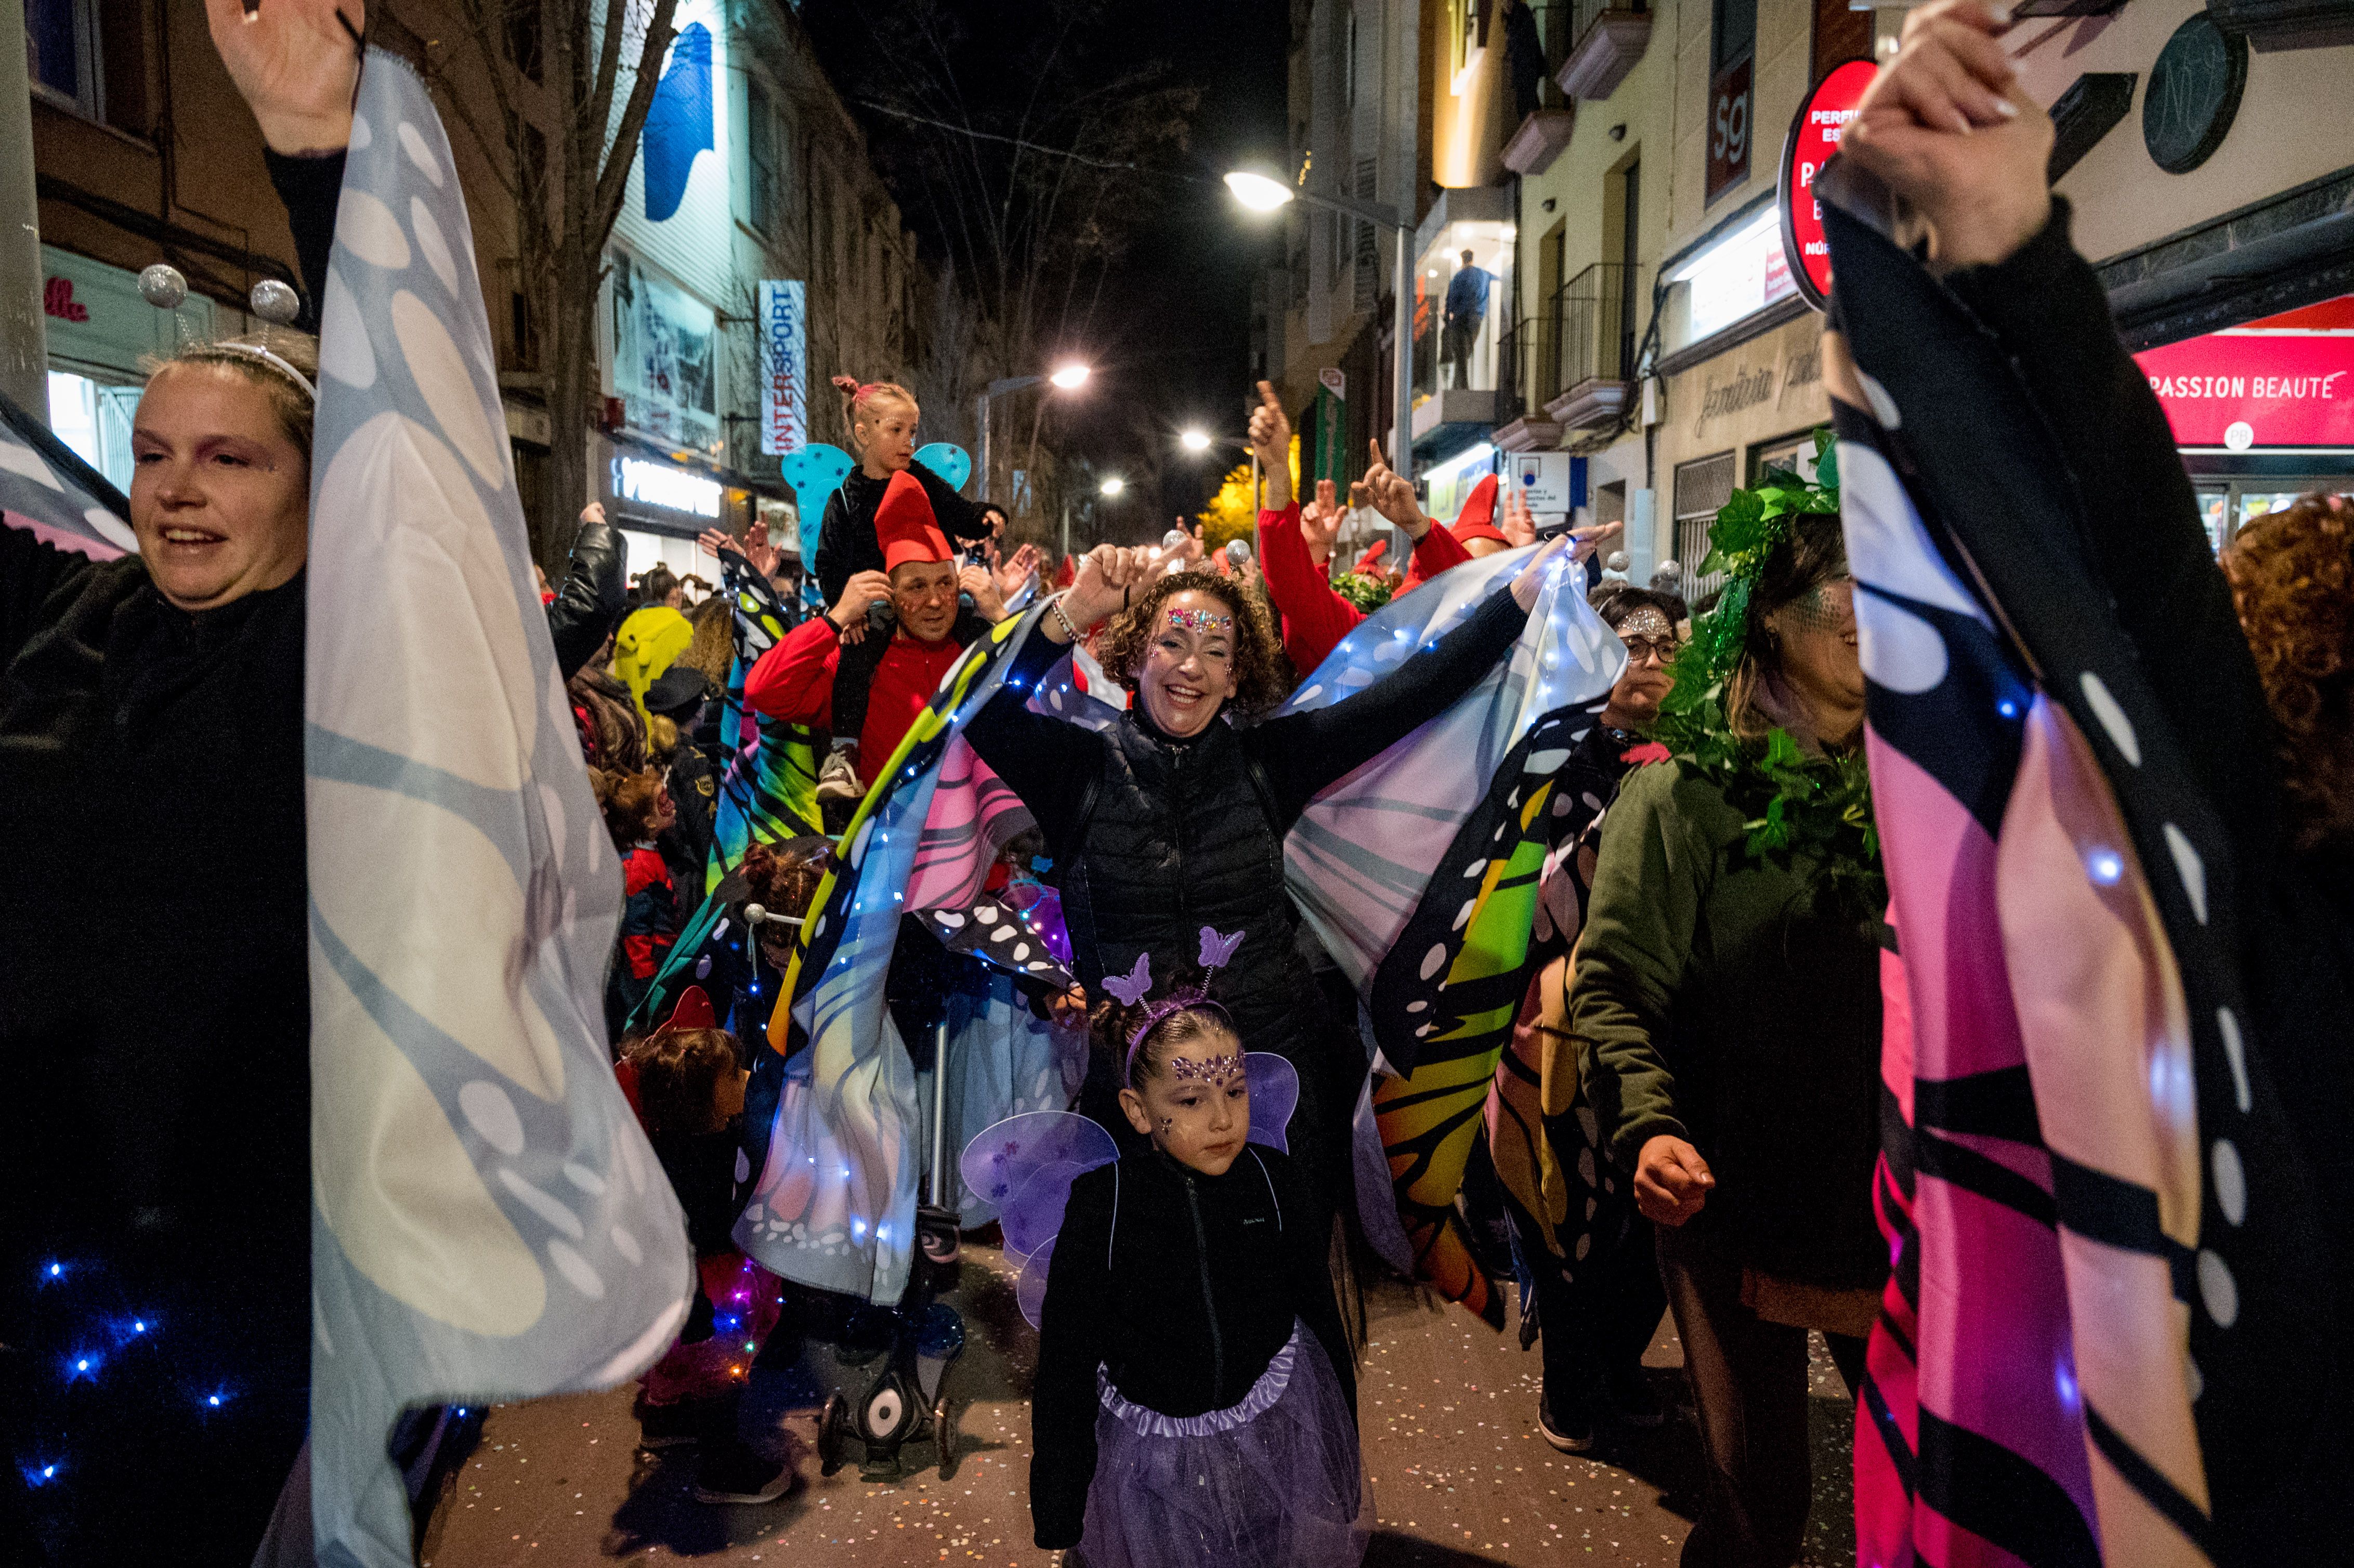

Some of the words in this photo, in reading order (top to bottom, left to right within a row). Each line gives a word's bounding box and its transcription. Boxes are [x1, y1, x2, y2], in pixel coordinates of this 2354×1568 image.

[1715, 90, 1747, 164] sg
[772, 288, 794, 451] INTERSPORT
[2149, 375, 2245, 398] PASSION
[2230, 429, 2248, 443] PB
